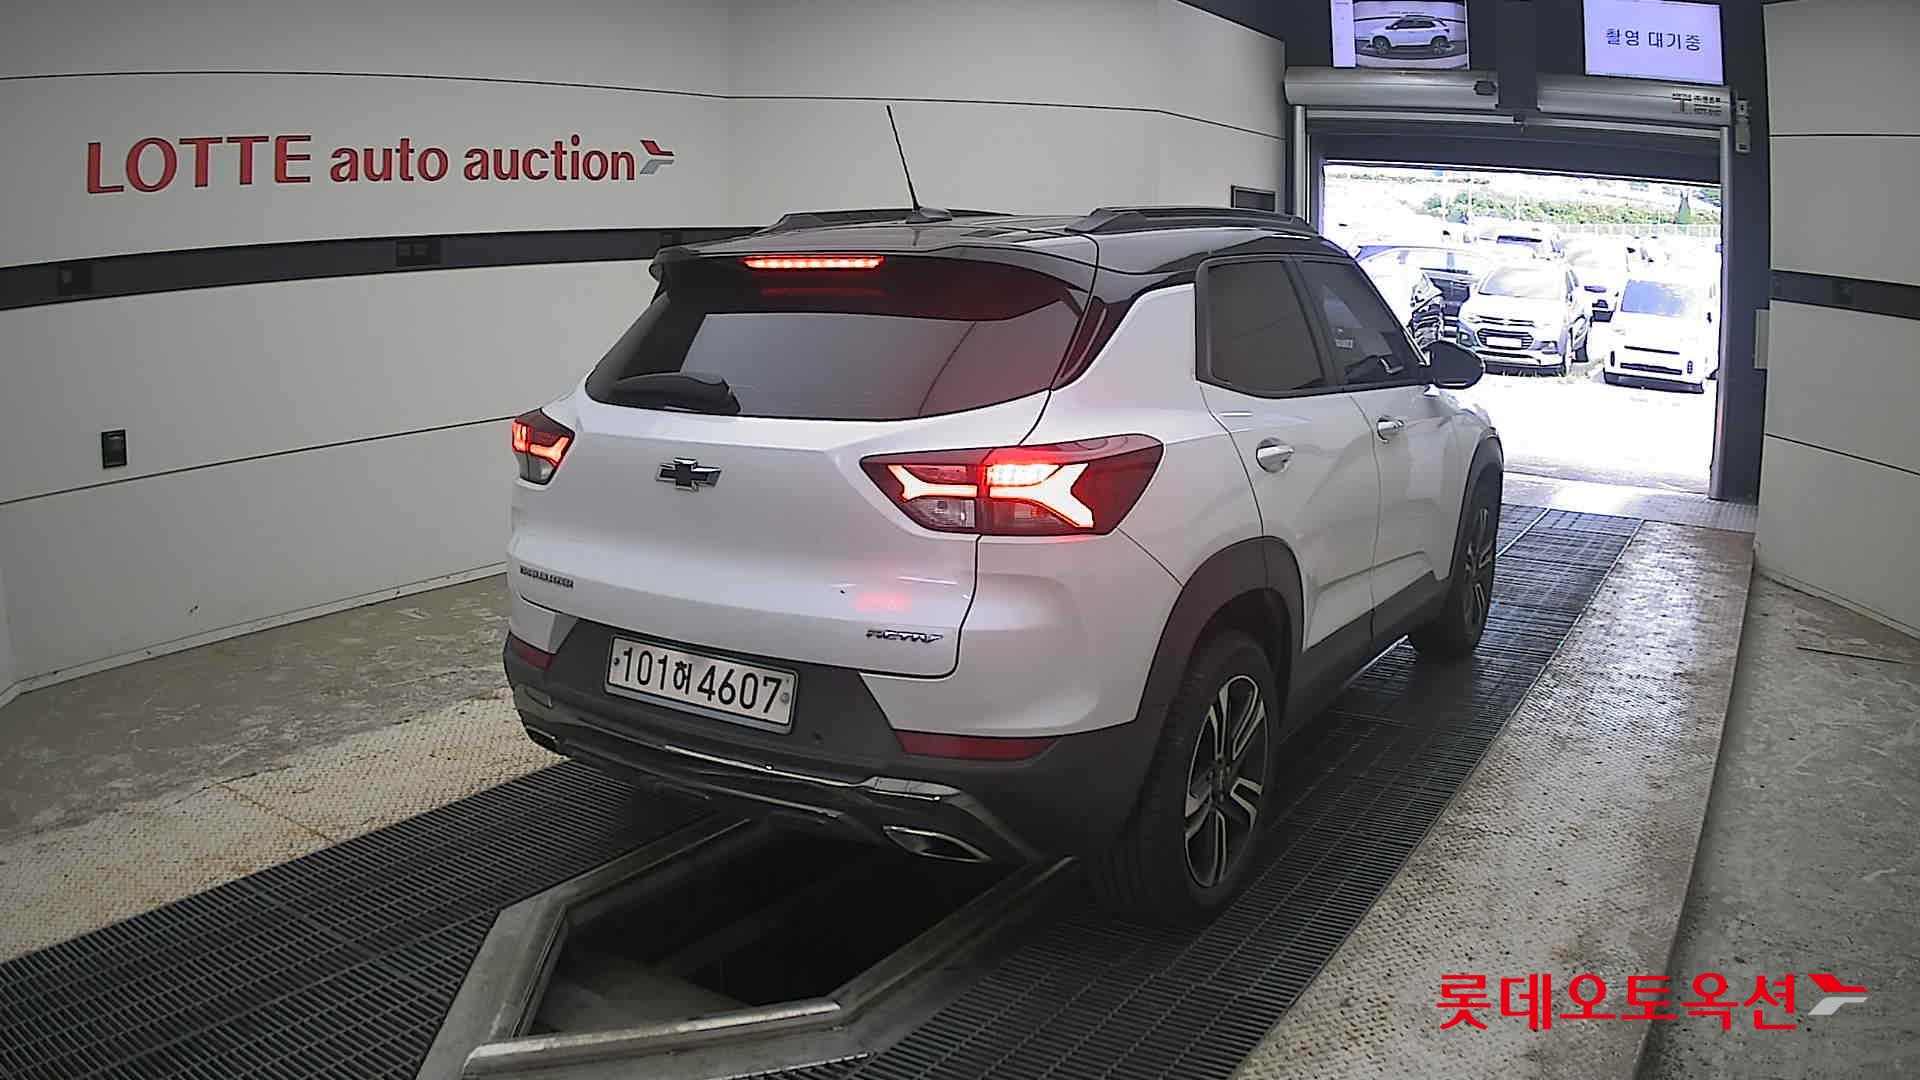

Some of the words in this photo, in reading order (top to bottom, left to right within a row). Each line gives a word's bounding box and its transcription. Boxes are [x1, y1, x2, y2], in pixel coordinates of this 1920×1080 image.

[1648, 31, 1701, 51] 대기중
[87, 134, 312, 194] LOTTE
[329, 137, 448, 183] auto
[463, 134, 635, 181] auction
